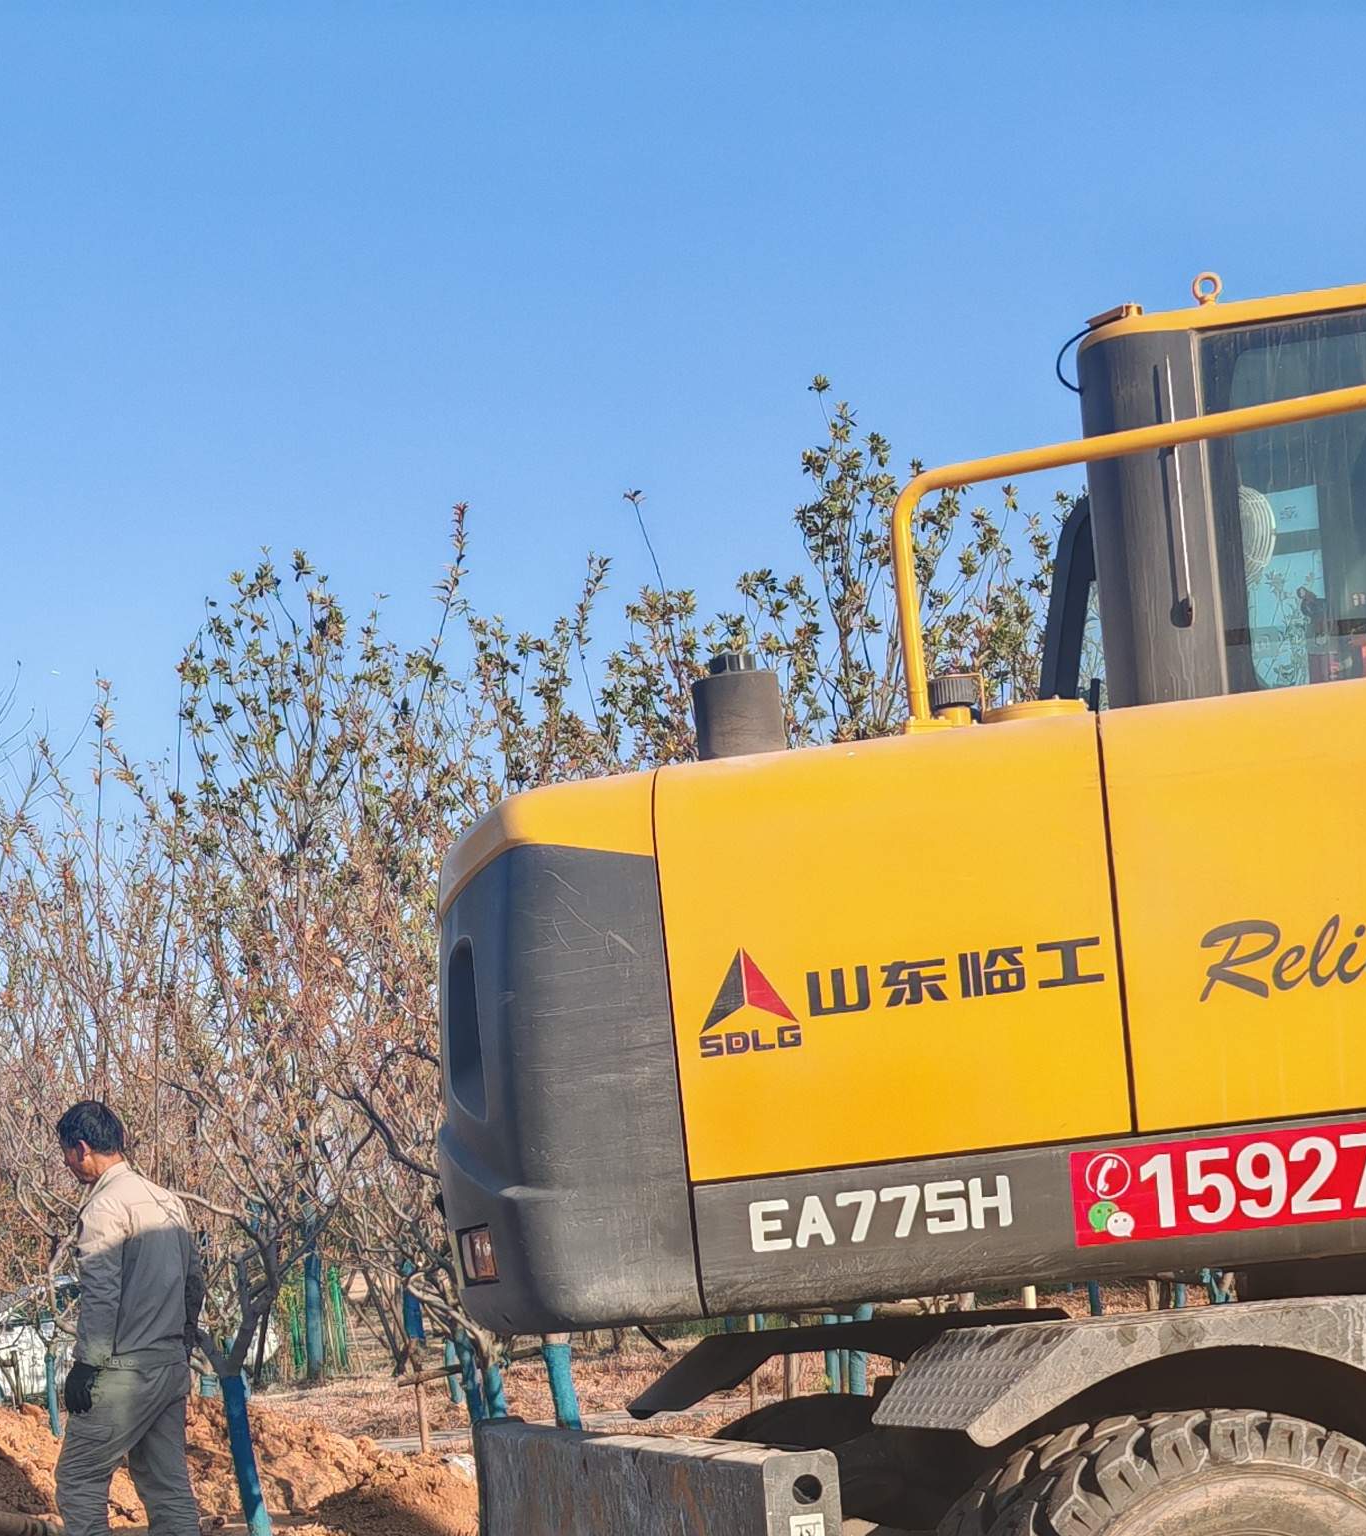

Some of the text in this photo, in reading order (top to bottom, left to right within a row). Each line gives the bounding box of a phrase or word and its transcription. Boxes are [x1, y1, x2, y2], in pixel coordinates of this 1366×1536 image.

[806, 936, 1105, 1017] 山东临工
[699, 1024, 803, 1059] SDLG
[748, 1174, 1013, 1253] EA775H
